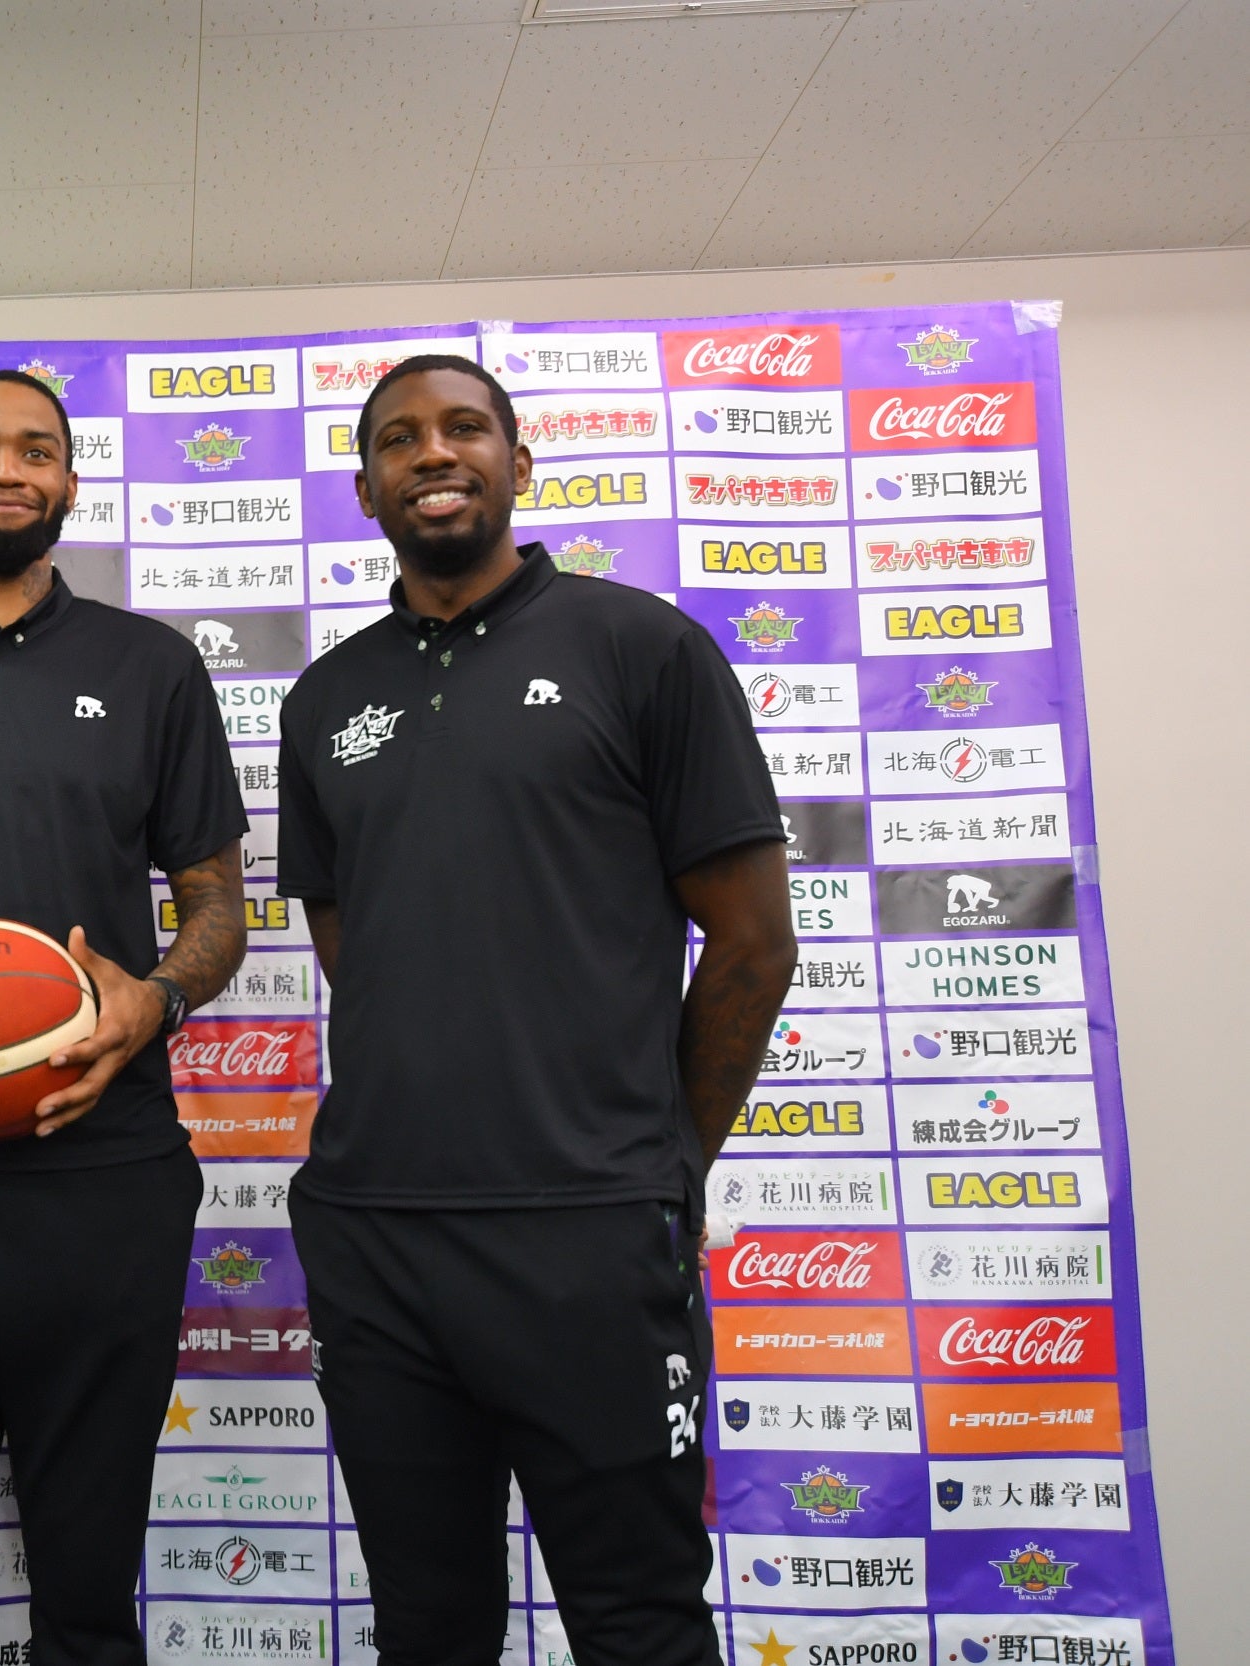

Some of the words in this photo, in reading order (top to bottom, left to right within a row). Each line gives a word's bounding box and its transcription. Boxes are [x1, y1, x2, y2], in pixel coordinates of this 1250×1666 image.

[538, 350, 647, 373] 野口観光
[683, 333, 819, 376] Coca-Cola
[149, 364, 274, 398] EAGLE
[514, 408, 657, 442] ーパー中古車市
[727, 407, 832, 434] 野口観光
[869, 393, 1013, 441] Coca-Cola
[912, 469, 1027, 497] 野口観光
[183, 498, 291, 525] 野口観光
[702, 540, 826, 574] EAGLE
[141, 565, 293, 589] 北海道新聞
[886, 604, 1023, 640] EAGLE
[793, 685, 843, 704] 電工
[883, 815, 1057, 843] 北海道新聞
[943, 915, 1006, 927] EGOZARU
[906, 944, 1057, 968] JOHNSON
[933, 975, 1041, 997] HOMES
[951, 1028, 1076, 1057] 野口観光
[760, 1048, 866, 1073] 会グループ
[913, 1118, 1081, 1144] 練成会グループ
[205, 1185, 286, 1208] 大藤学
[759, 1182, 873, 1205] 花川病院
[926, 1172, 1081, 1209] EAGLE
[727, 1241, 878, 1289] Coca-Cola
[971, 1255, 1089, 1279] 花川病院
[736, 1332, 885, 1348] トヨタカローラ札幌
[939, 1316, 1091, 1367] Coca-Cola
[209, 1407, 314, 1427] SAPPORO
[667, 1395, 699, 1458] 24
[788, 1404, 912, 1431] 大藤学園
[949, 1409, 1094, 1426] トヨタカローラ札幌
[157, 1494, 232, 1509] EAGLE
[239, 1495, 317, 1510] GROUP
[999, 1482, 1121, 1508] 大藤学園
[791, 1557, 913, 1588] 野口観光
[202, 1627, 312, 1651] 花川病院
[998, 1634, 1131, 1666] 野口観光
[809, 1642, 917, 1665] SAPPORO
